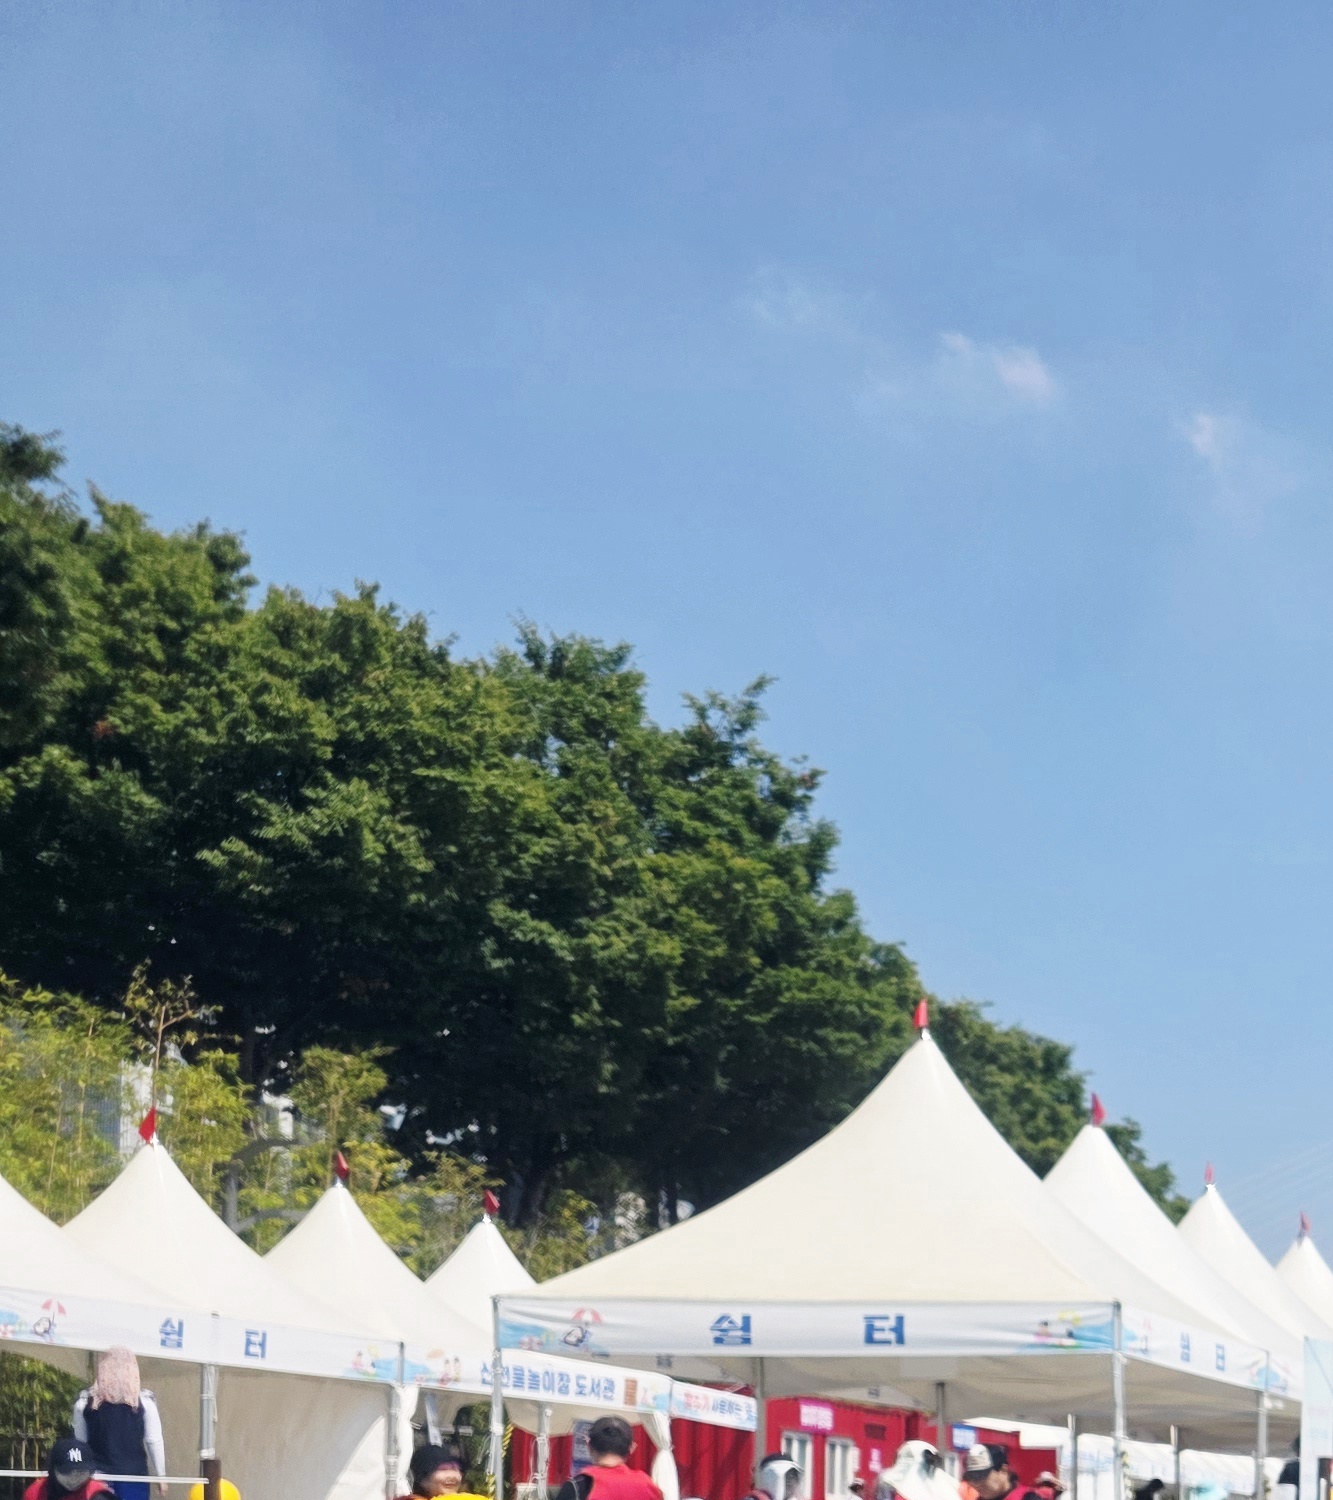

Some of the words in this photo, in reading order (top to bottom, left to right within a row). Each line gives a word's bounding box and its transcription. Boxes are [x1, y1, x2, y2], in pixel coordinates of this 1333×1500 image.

[160, 1318, 183, 1349] 쉼
[244, 1329, 267, 1359] 터
[710, 1314, 752, 1345] 쉼
[864, 1314, 905, 1345] 터
